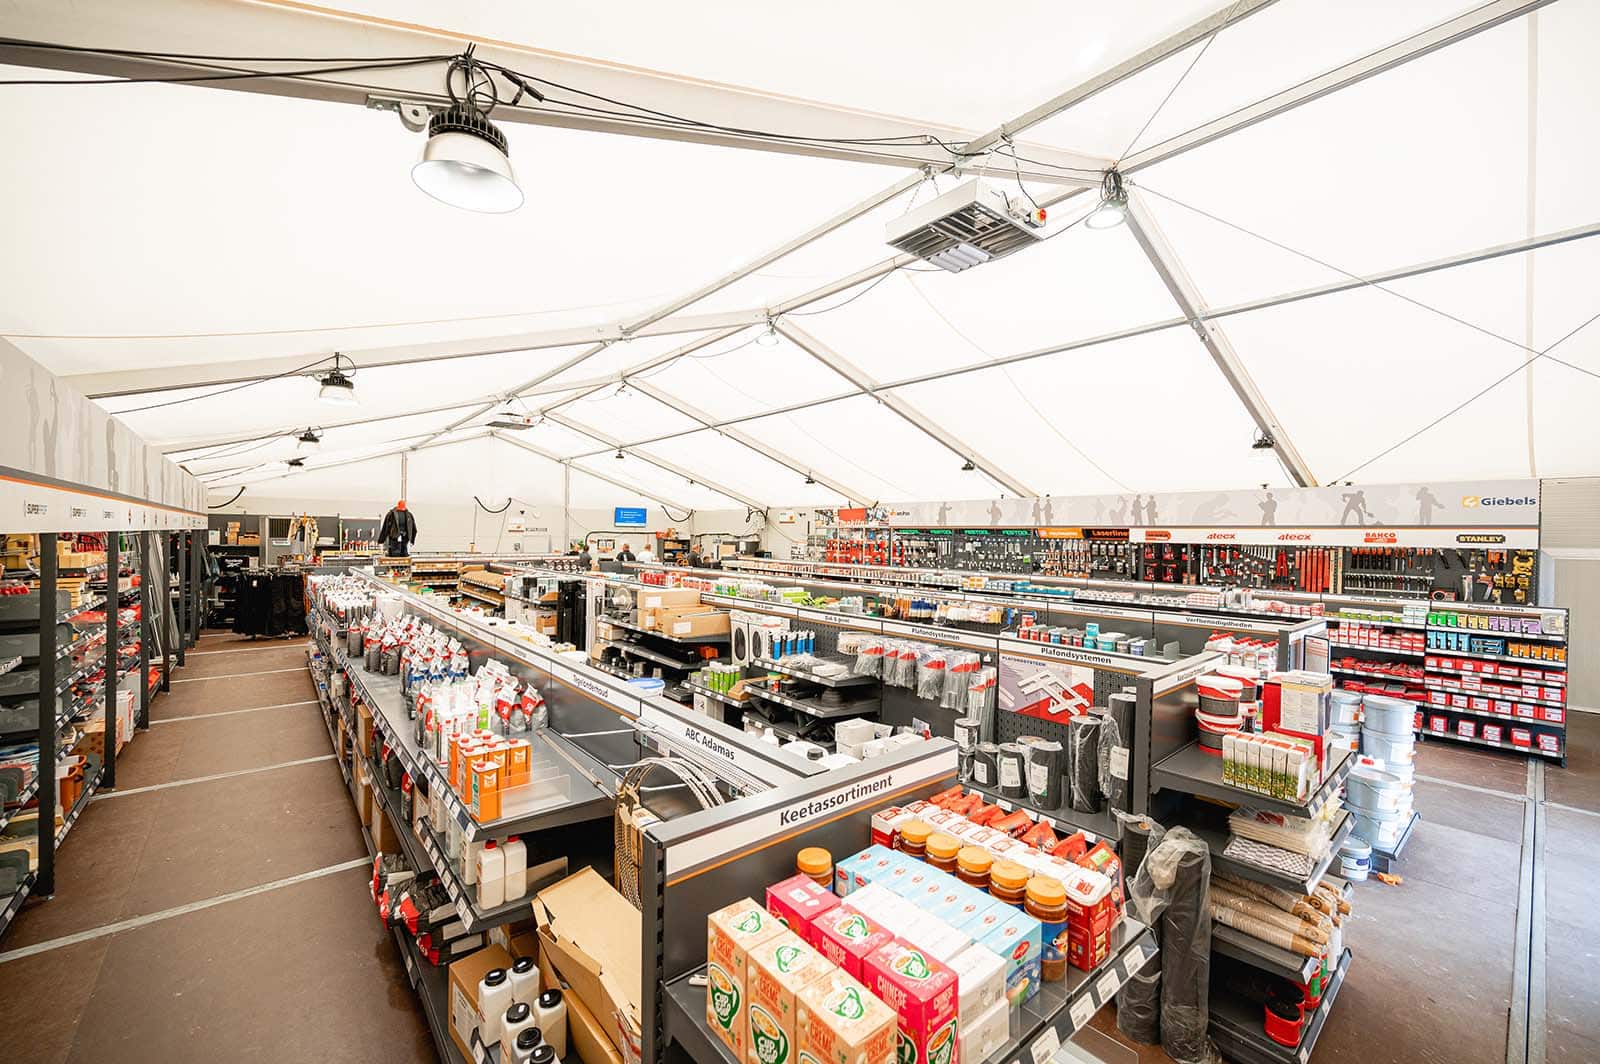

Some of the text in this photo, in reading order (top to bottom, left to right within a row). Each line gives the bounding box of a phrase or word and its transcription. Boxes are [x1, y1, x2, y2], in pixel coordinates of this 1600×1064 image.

[1481, 497, 1537, 506] Giebels
[1092, 529, 1128, 537] Laserline
[1185, 617, 1253, 628] Verfbenodigdheden
[911, 628, 960, 641] Plafondsystemen
[1041, 647, 1112, 665] Plafondsystemen
[685, 727, 735, 760] ABC Adamas
[779, 774, 893, 826] Keetassortiment
[877, 975, 907, 1010] CHINESE
